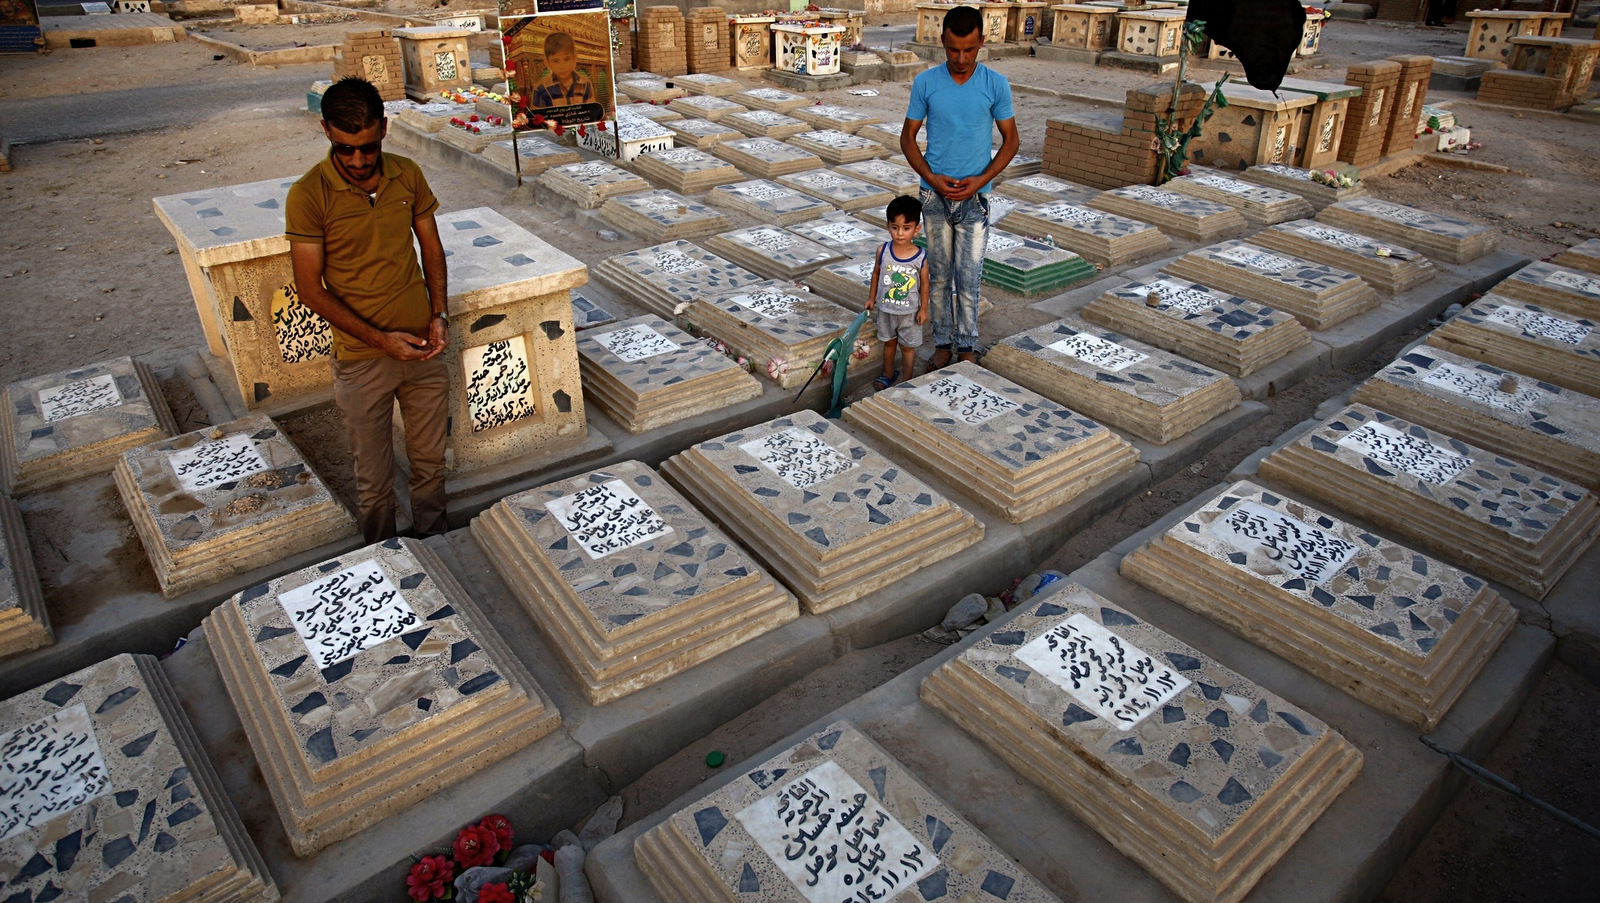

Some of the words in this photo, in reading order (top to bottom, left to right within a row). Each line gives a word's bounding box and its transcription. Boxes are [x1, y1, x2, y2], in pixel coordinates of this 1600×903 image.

[887, 265, 917, 275] SUPER
[227, 445, 253, 461] جميل
[1280, 517, 1301, 539] محمد
[1284, 544, 1307, 570] موصل
[324, 588, 351, 616] علي
[370, 590, 397, 612] موصل
[1130, 656, 1155, 685] موصل
[52, 752, 95, 781] موصل
[804, 843, 839, 887] موصل
